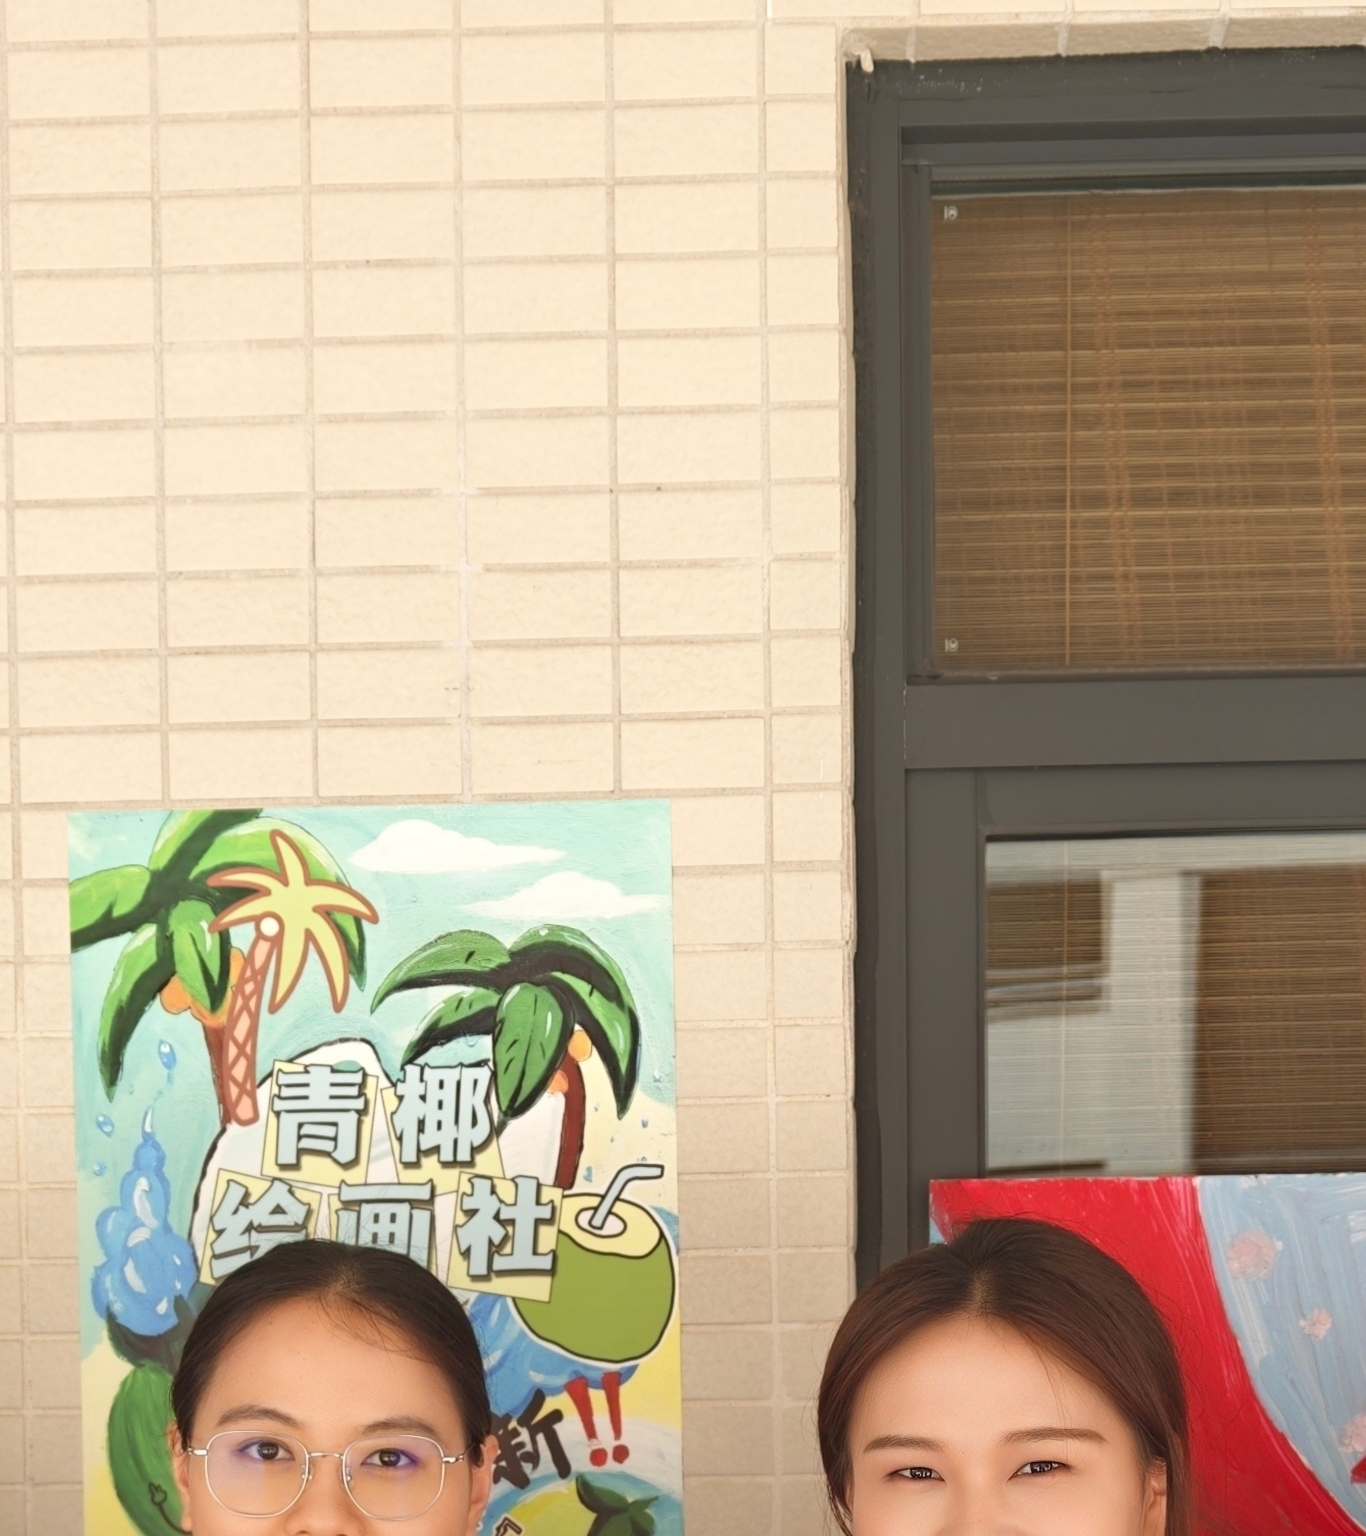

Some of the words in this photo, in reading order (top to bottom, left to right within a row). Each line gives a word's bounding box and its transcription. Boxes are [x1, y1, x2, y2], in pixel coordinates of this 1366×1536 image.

[272, 1063, 493, 1168] 青椰
[211, 1175, 556, 1278] 绘画社
